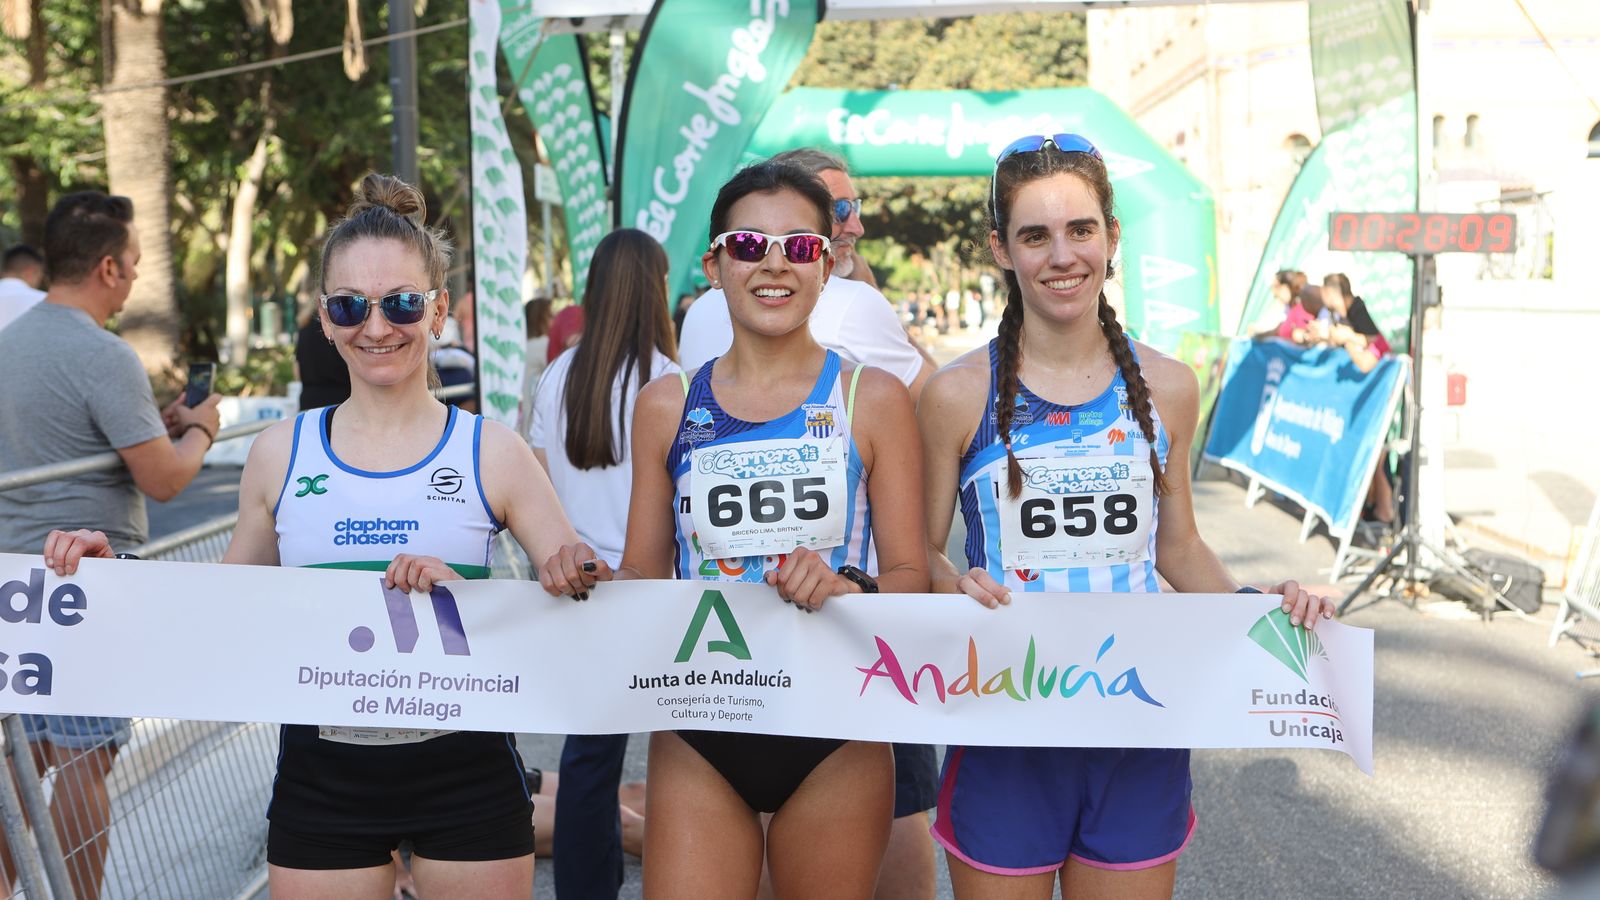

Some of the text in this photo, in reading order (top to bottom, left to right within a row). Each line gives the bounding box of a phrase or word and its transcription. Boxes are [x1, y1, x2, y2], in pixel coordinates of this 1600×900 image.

[653, 113, 719, 204] Corte
[1333, 214, 1513, 252] 00:28:09
[995, 430, 1029, 446] vve
[714, 447, 800, 471] Carrera
[1031, 466, 1112, 485] Carrera
[427, 495, 466, 503] SCIMITAR
[708, 477, 829, 527] 665
[334, 518, 419, 534] clapham
[1020, 494, 1138, 538] 658
[334, 531, 408, 545] chasers
[0, 568, 87, 626] de
[0, 651, 53, 696] a
[298, 666, 520, 693] Diputación Provincial
[629, 669, 792, 690] Junta de Andalucía
[855, 633, 1166, 709] Andalucía
[352, 696, 462, 721] de Málaga
[657, 694, 765, 709] Consejería de Turismo,
[1251, 688, 1340, 713] Fundaci
[671, 708, 753, 722] Cultura y Deporte
[1269, 716, 1344, 744] Unicaja
